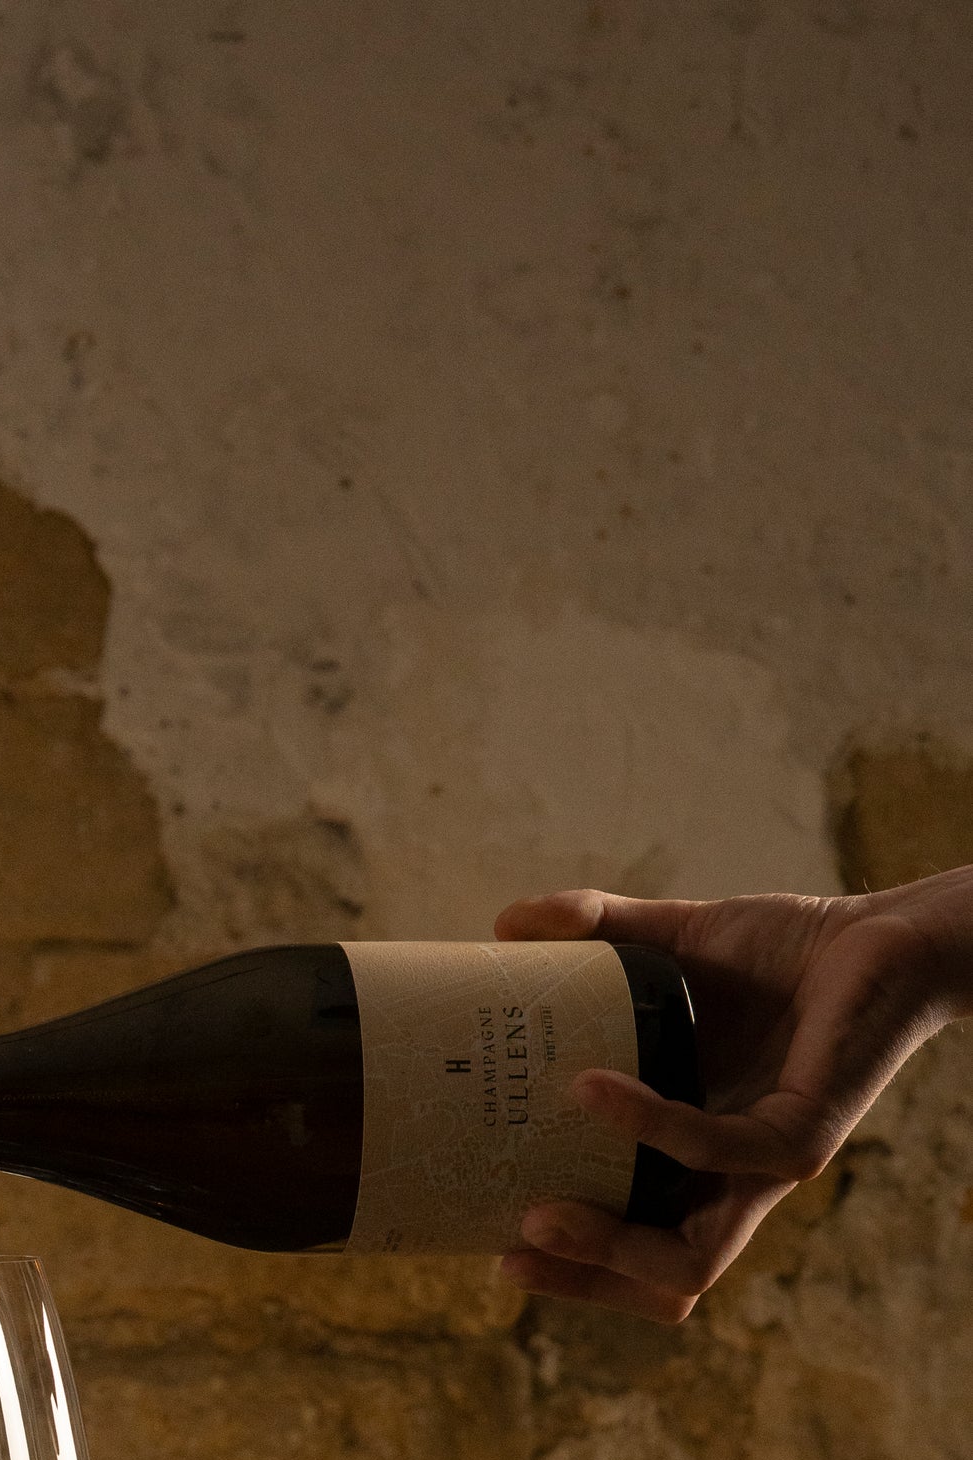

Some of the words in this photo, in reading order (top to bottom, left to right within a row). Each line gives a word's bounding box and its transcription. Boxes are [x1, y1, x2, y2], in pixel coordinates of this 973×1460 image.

[445, 1060, 471, 1073] H
[479, 1006, 497, 1127] CHAMPAGNE
[503, 1006, 529, 1126] ULLENS
